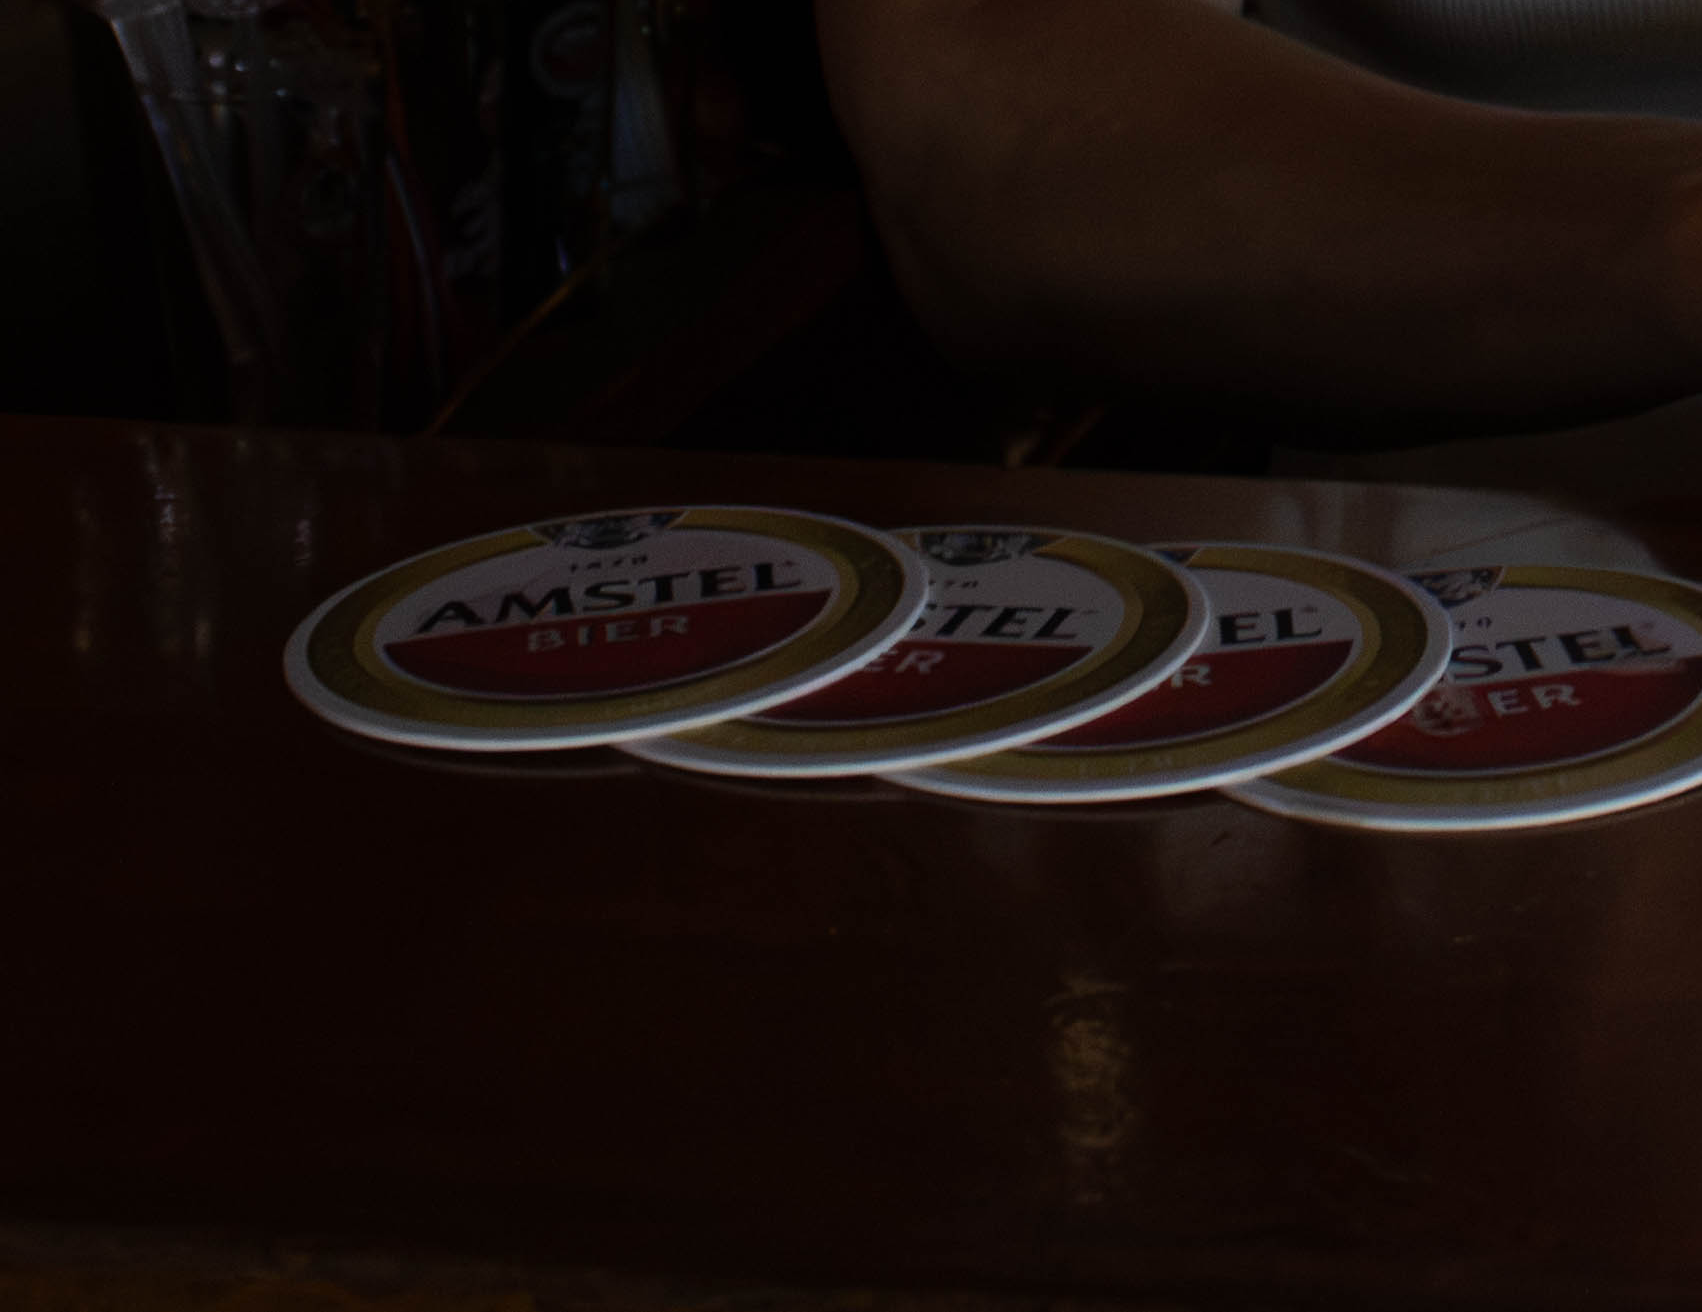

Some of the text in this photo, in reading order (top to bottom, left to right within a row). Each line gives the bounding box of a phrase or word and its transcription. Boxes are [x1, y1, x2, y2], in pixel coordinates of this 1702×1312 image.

[416, 562, 803, 634] AMSTEL
[527, 614, 690, 655] BIER
[911, 603, 1078, 639] TEL
[862, 647, 946, 674] ER
[1448, 625, 1671, 681] STEL
[1487, 682, 1584, 718] ER
